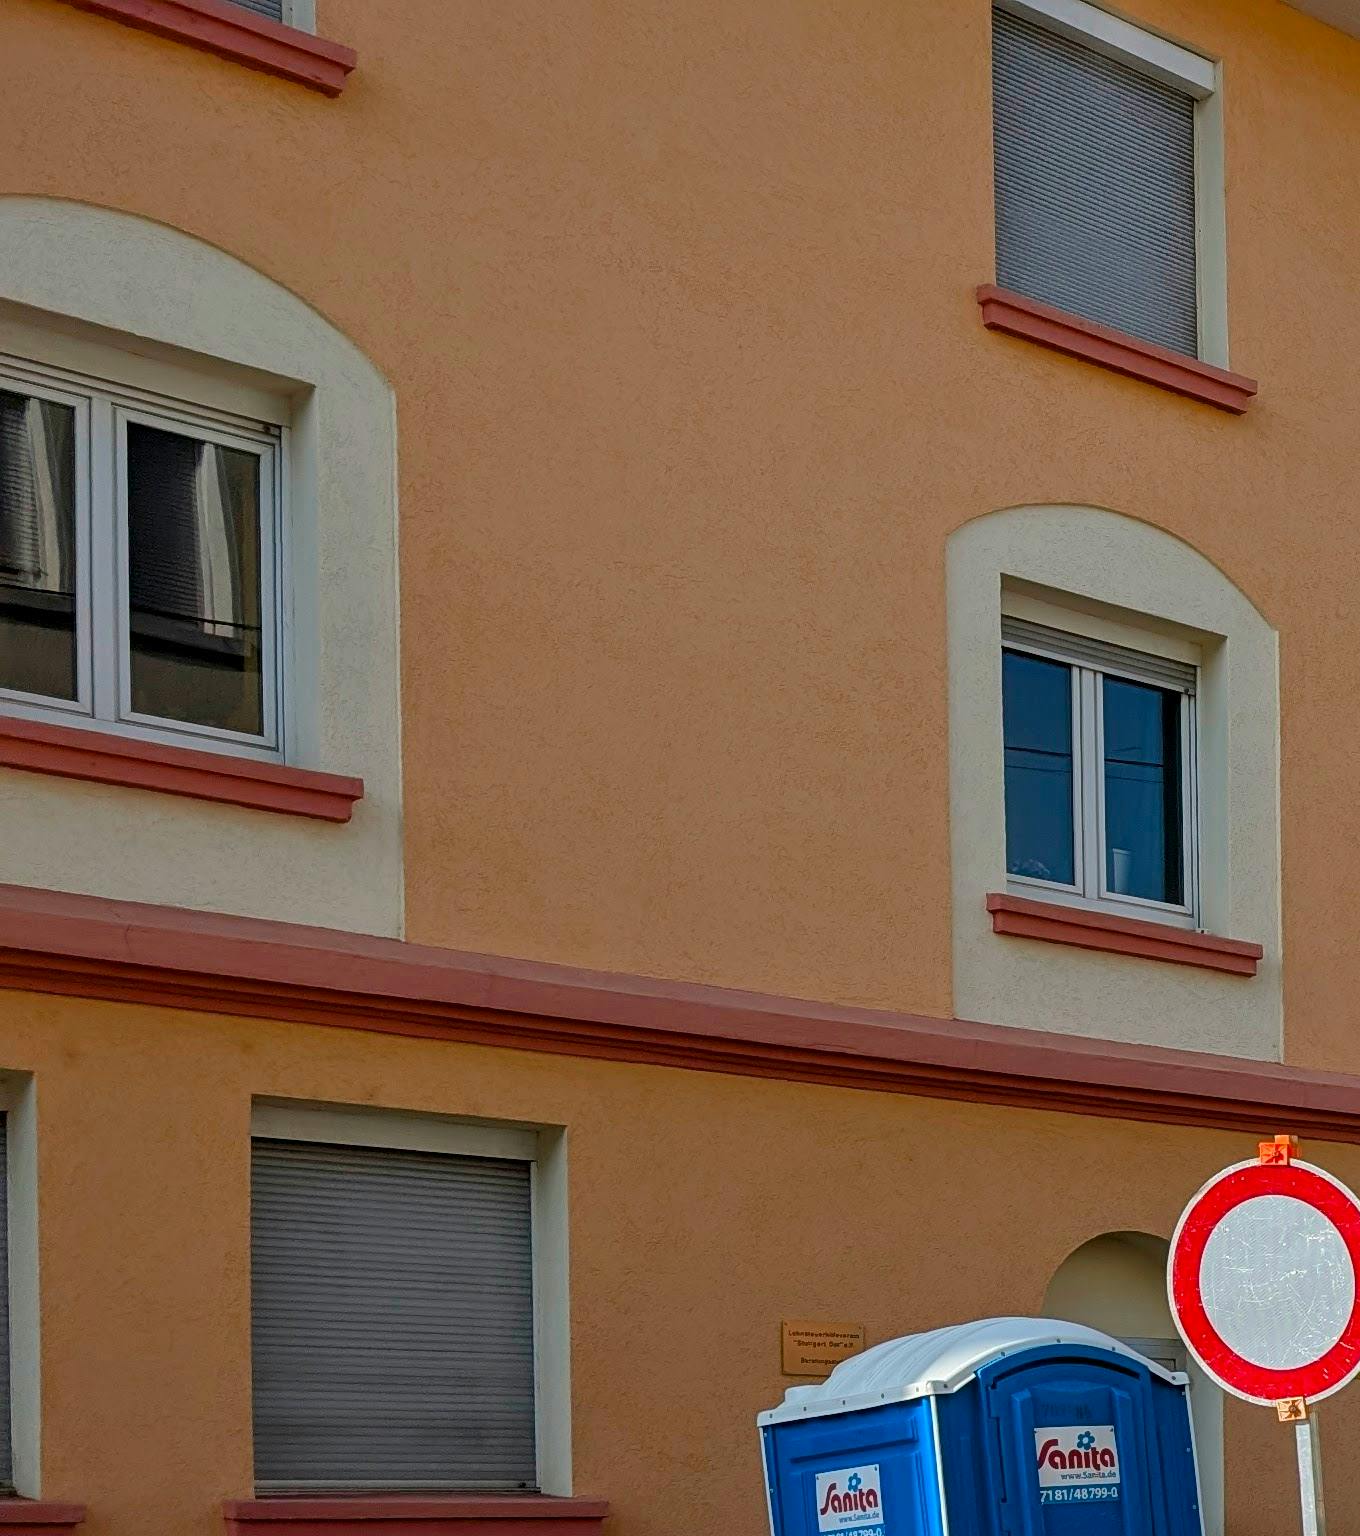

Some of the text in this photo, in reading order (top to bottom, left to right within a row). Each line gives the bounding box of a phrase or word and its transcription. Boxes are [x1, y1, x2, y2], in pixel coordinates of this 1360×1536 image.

[1038, 1438, 1116, 1471] Sanita
[820, 1482, 879, 1516] Sanita
[1039, 1486, 1118, 1503] 7181/48799-0
